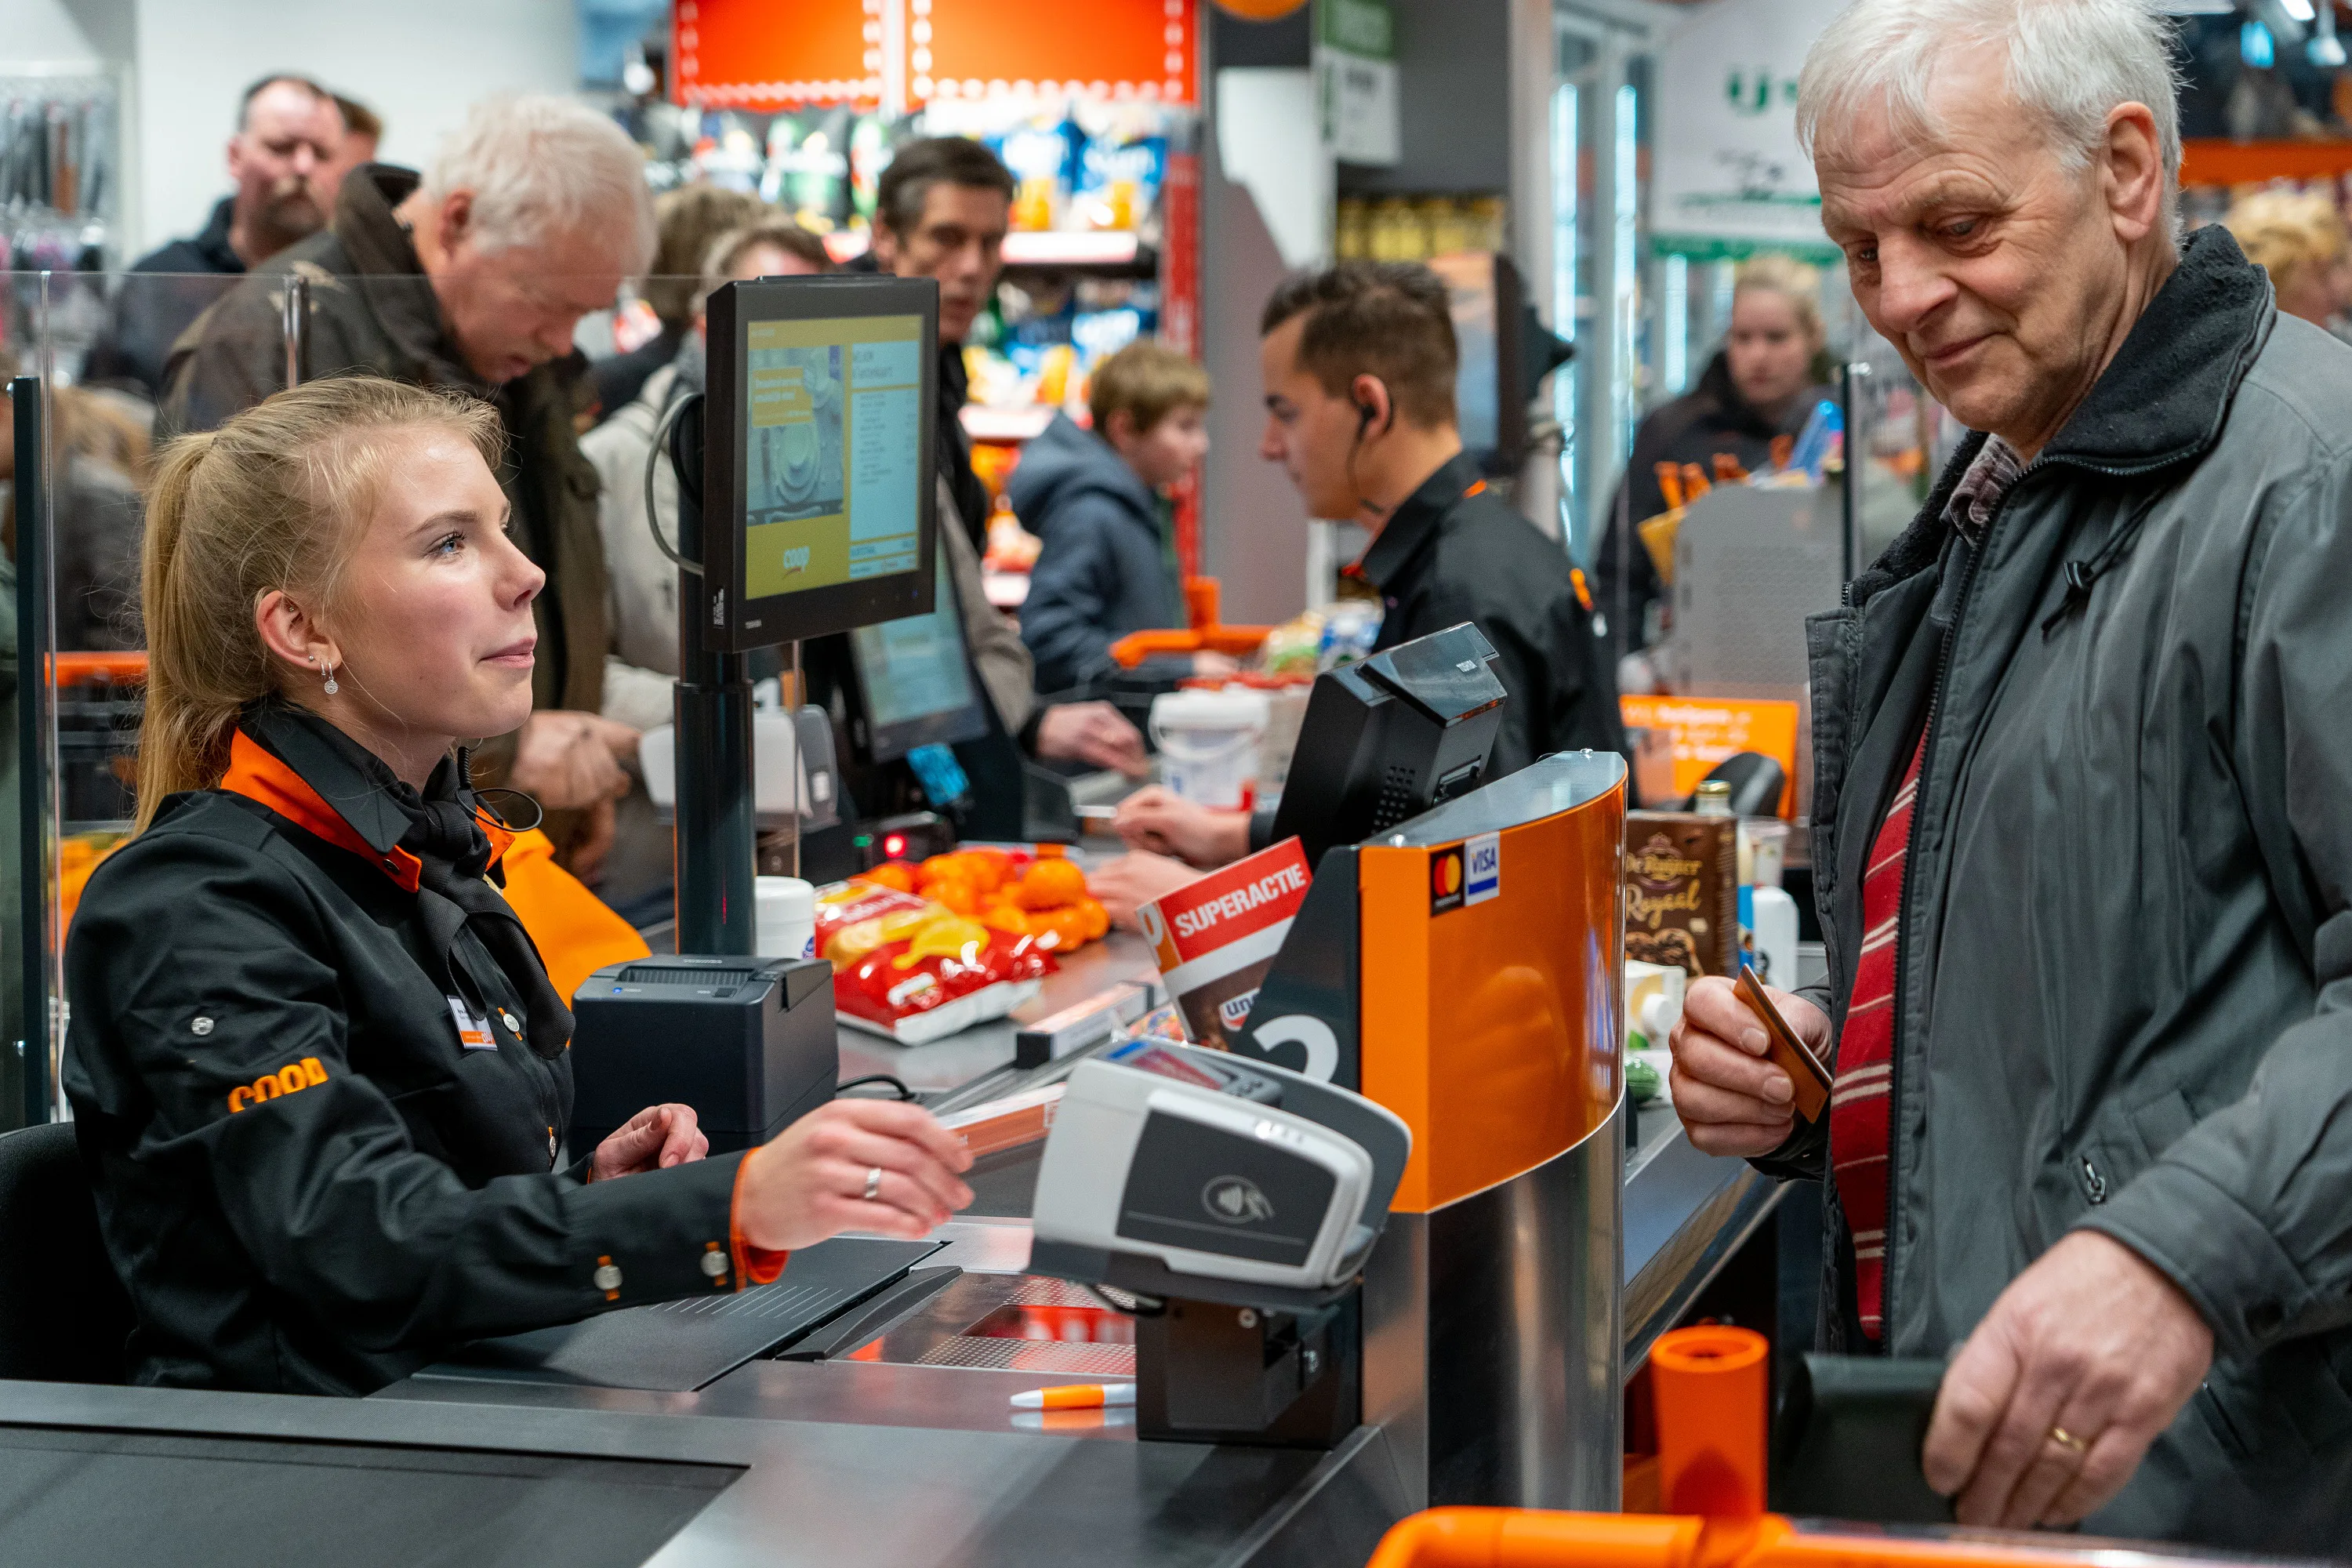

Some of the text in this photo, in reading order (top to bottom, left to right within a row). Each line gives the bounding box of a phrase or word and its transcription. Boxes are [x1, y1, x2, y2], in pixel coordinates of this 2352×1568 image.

[1470, 846, 1497, 875] VISA
[1174, 863, 1306, 938] SUPERACTIE
[1225, 995, 1254, 1017] un
